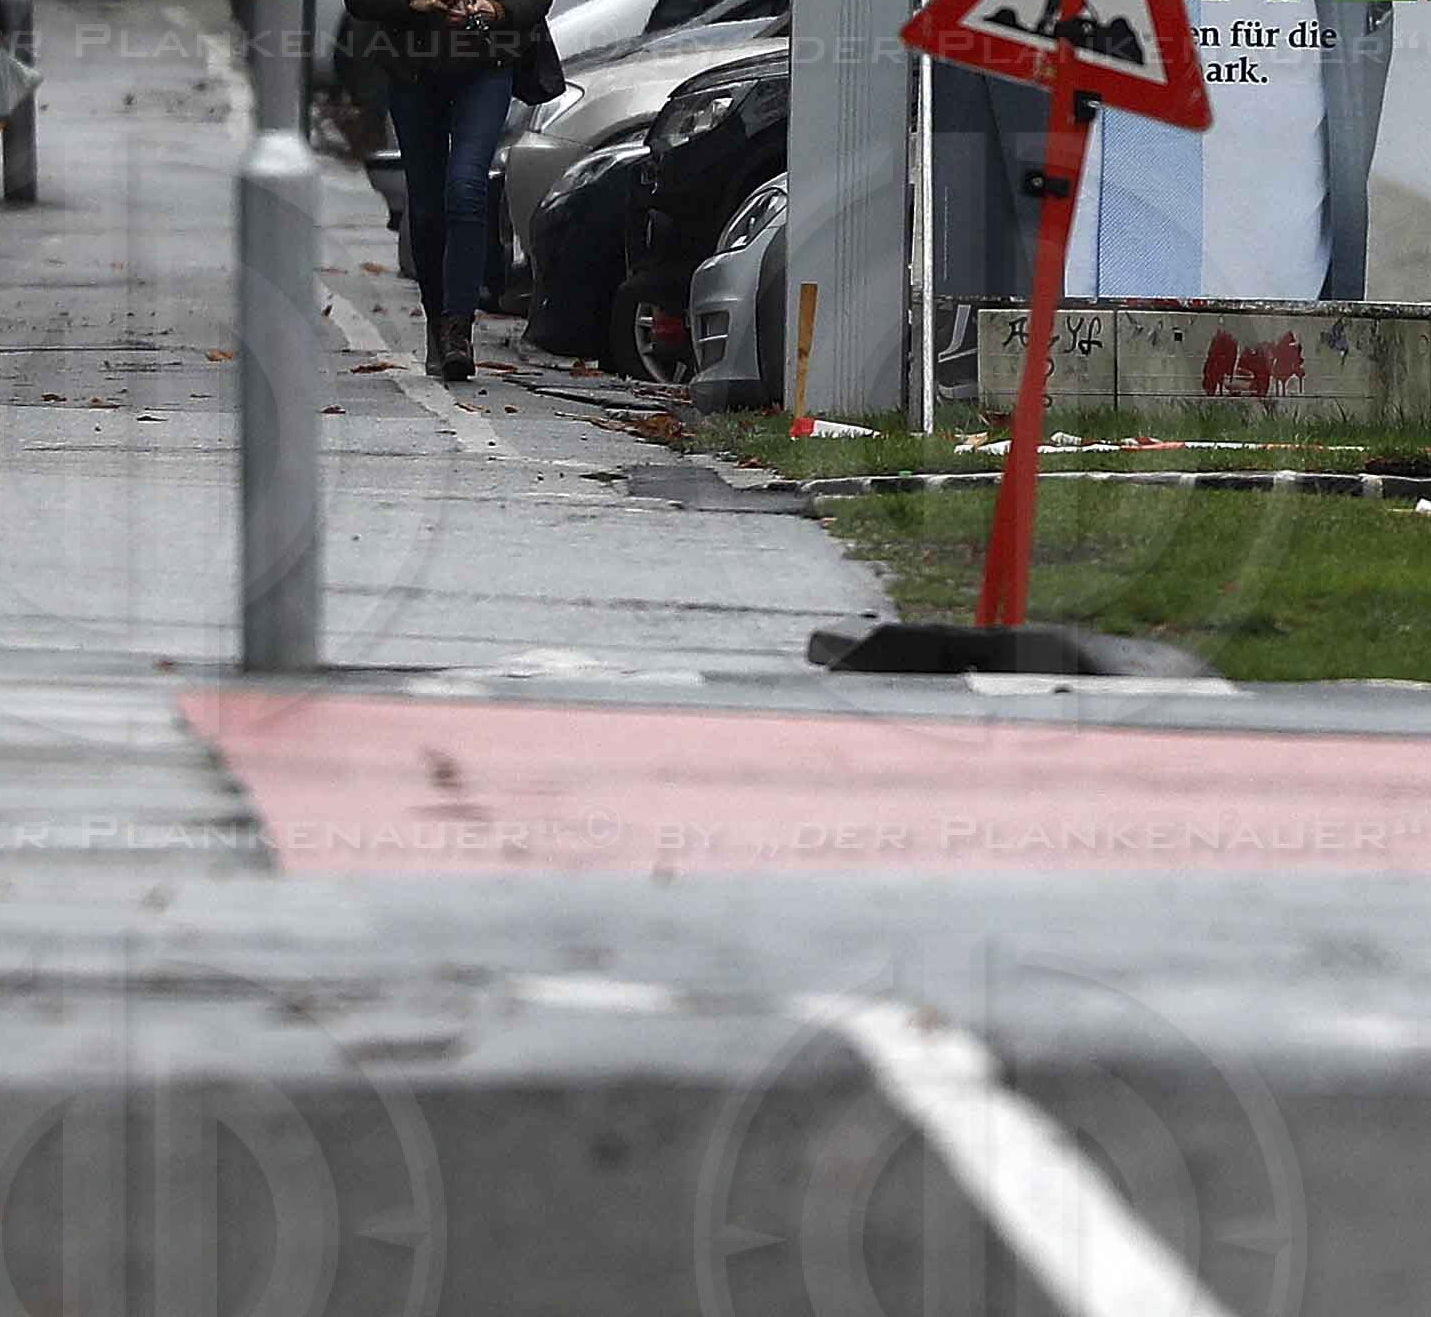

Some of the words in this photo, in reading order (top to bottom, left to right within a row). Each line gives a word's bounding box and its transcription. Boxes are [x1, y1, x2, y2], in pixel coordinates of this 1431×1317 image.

[1189, 26, 1221, 48] en
[1230, 19, 1281, 49] für
[1289, 19, 1338, 49] die
[1204, 58, 1269, 84] ark.
